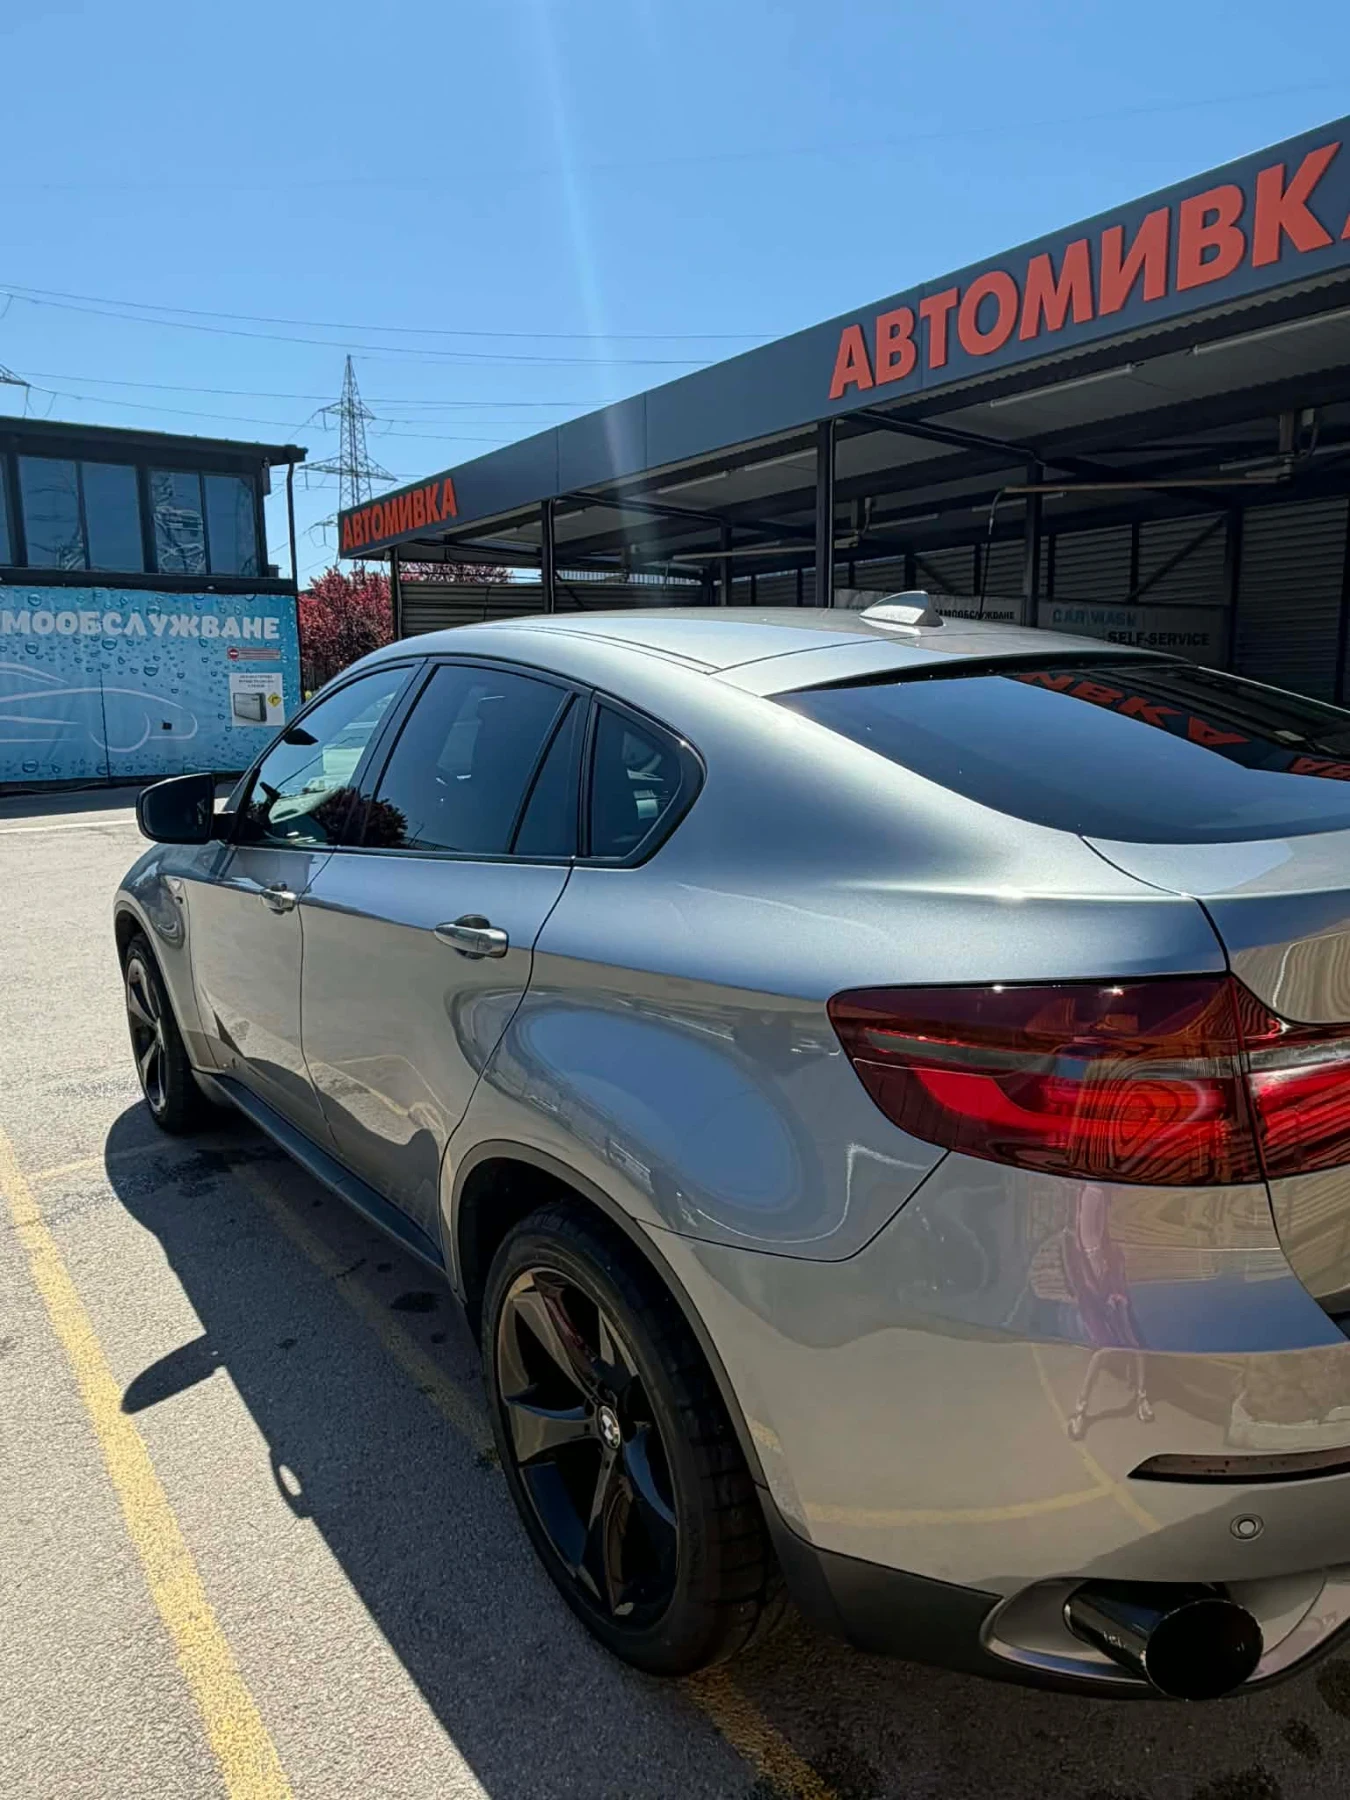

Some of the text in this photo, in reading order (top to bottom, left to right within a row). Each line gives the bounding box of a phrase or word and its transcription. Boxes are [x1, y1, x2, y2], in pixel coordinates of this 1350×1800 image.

[828, 141, 1350, 400] АВТОМИВК
[343, 477, 458, 550] АВТОМИВКА
[1053, 609, 1137, 627] CAR WASH
[1108, 630, 1210, 647] SELF-SERVICE
